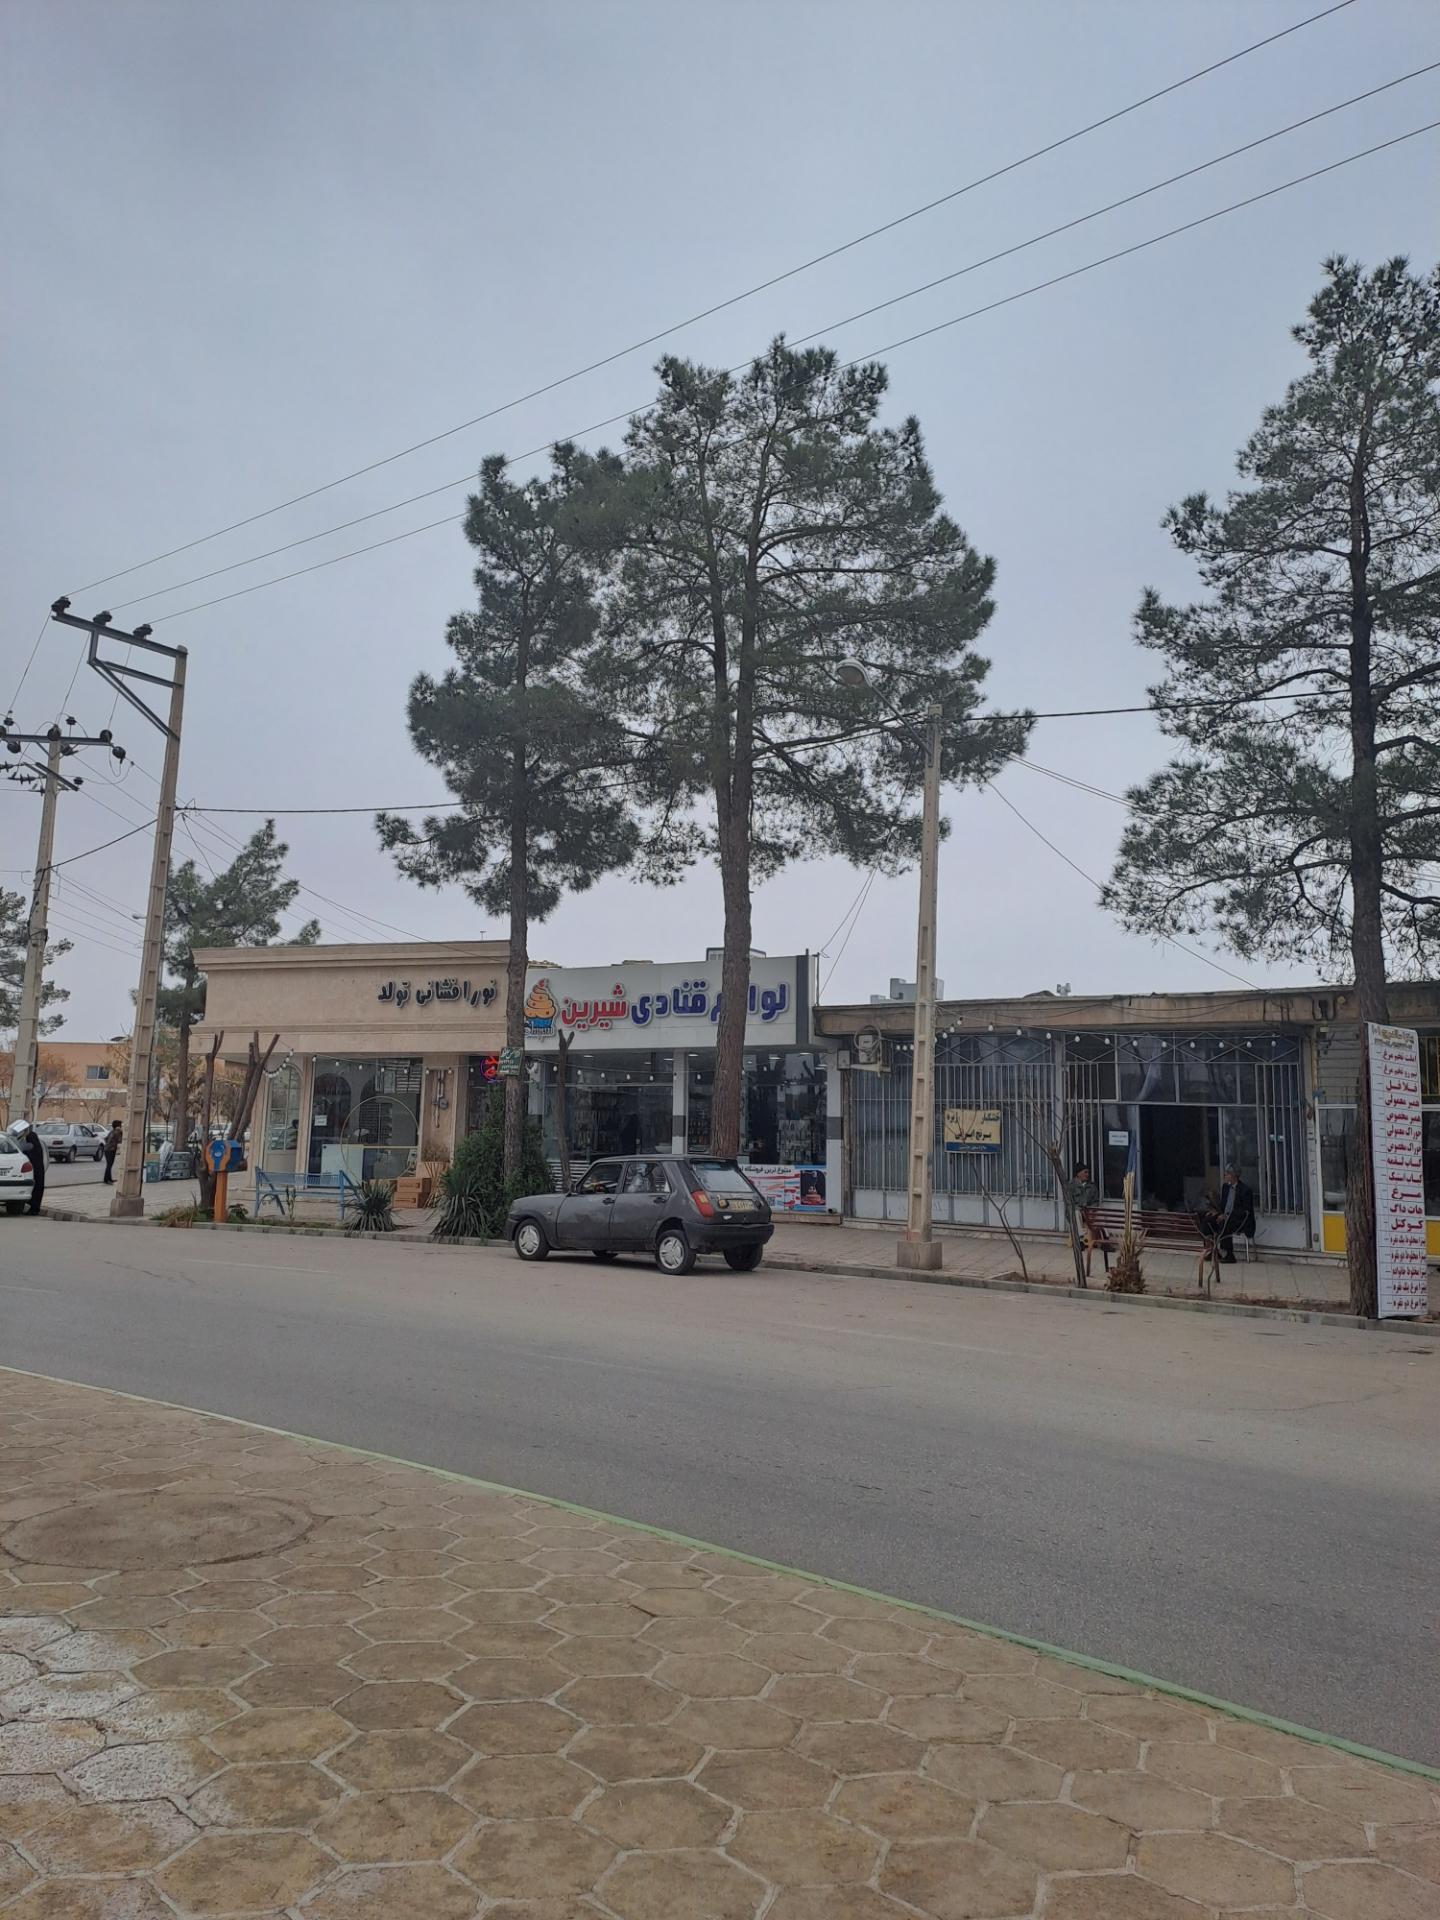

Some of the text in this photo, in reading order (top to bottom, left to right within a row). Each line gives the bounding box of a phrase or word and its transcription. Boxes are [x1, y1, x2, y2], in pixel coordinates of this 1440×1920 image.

[378, 979, 410, 1007] تولد
[560, 979, 790, 1031] لوام قنادی شیرین
[1407, 1204, 1423, 1214] هات
